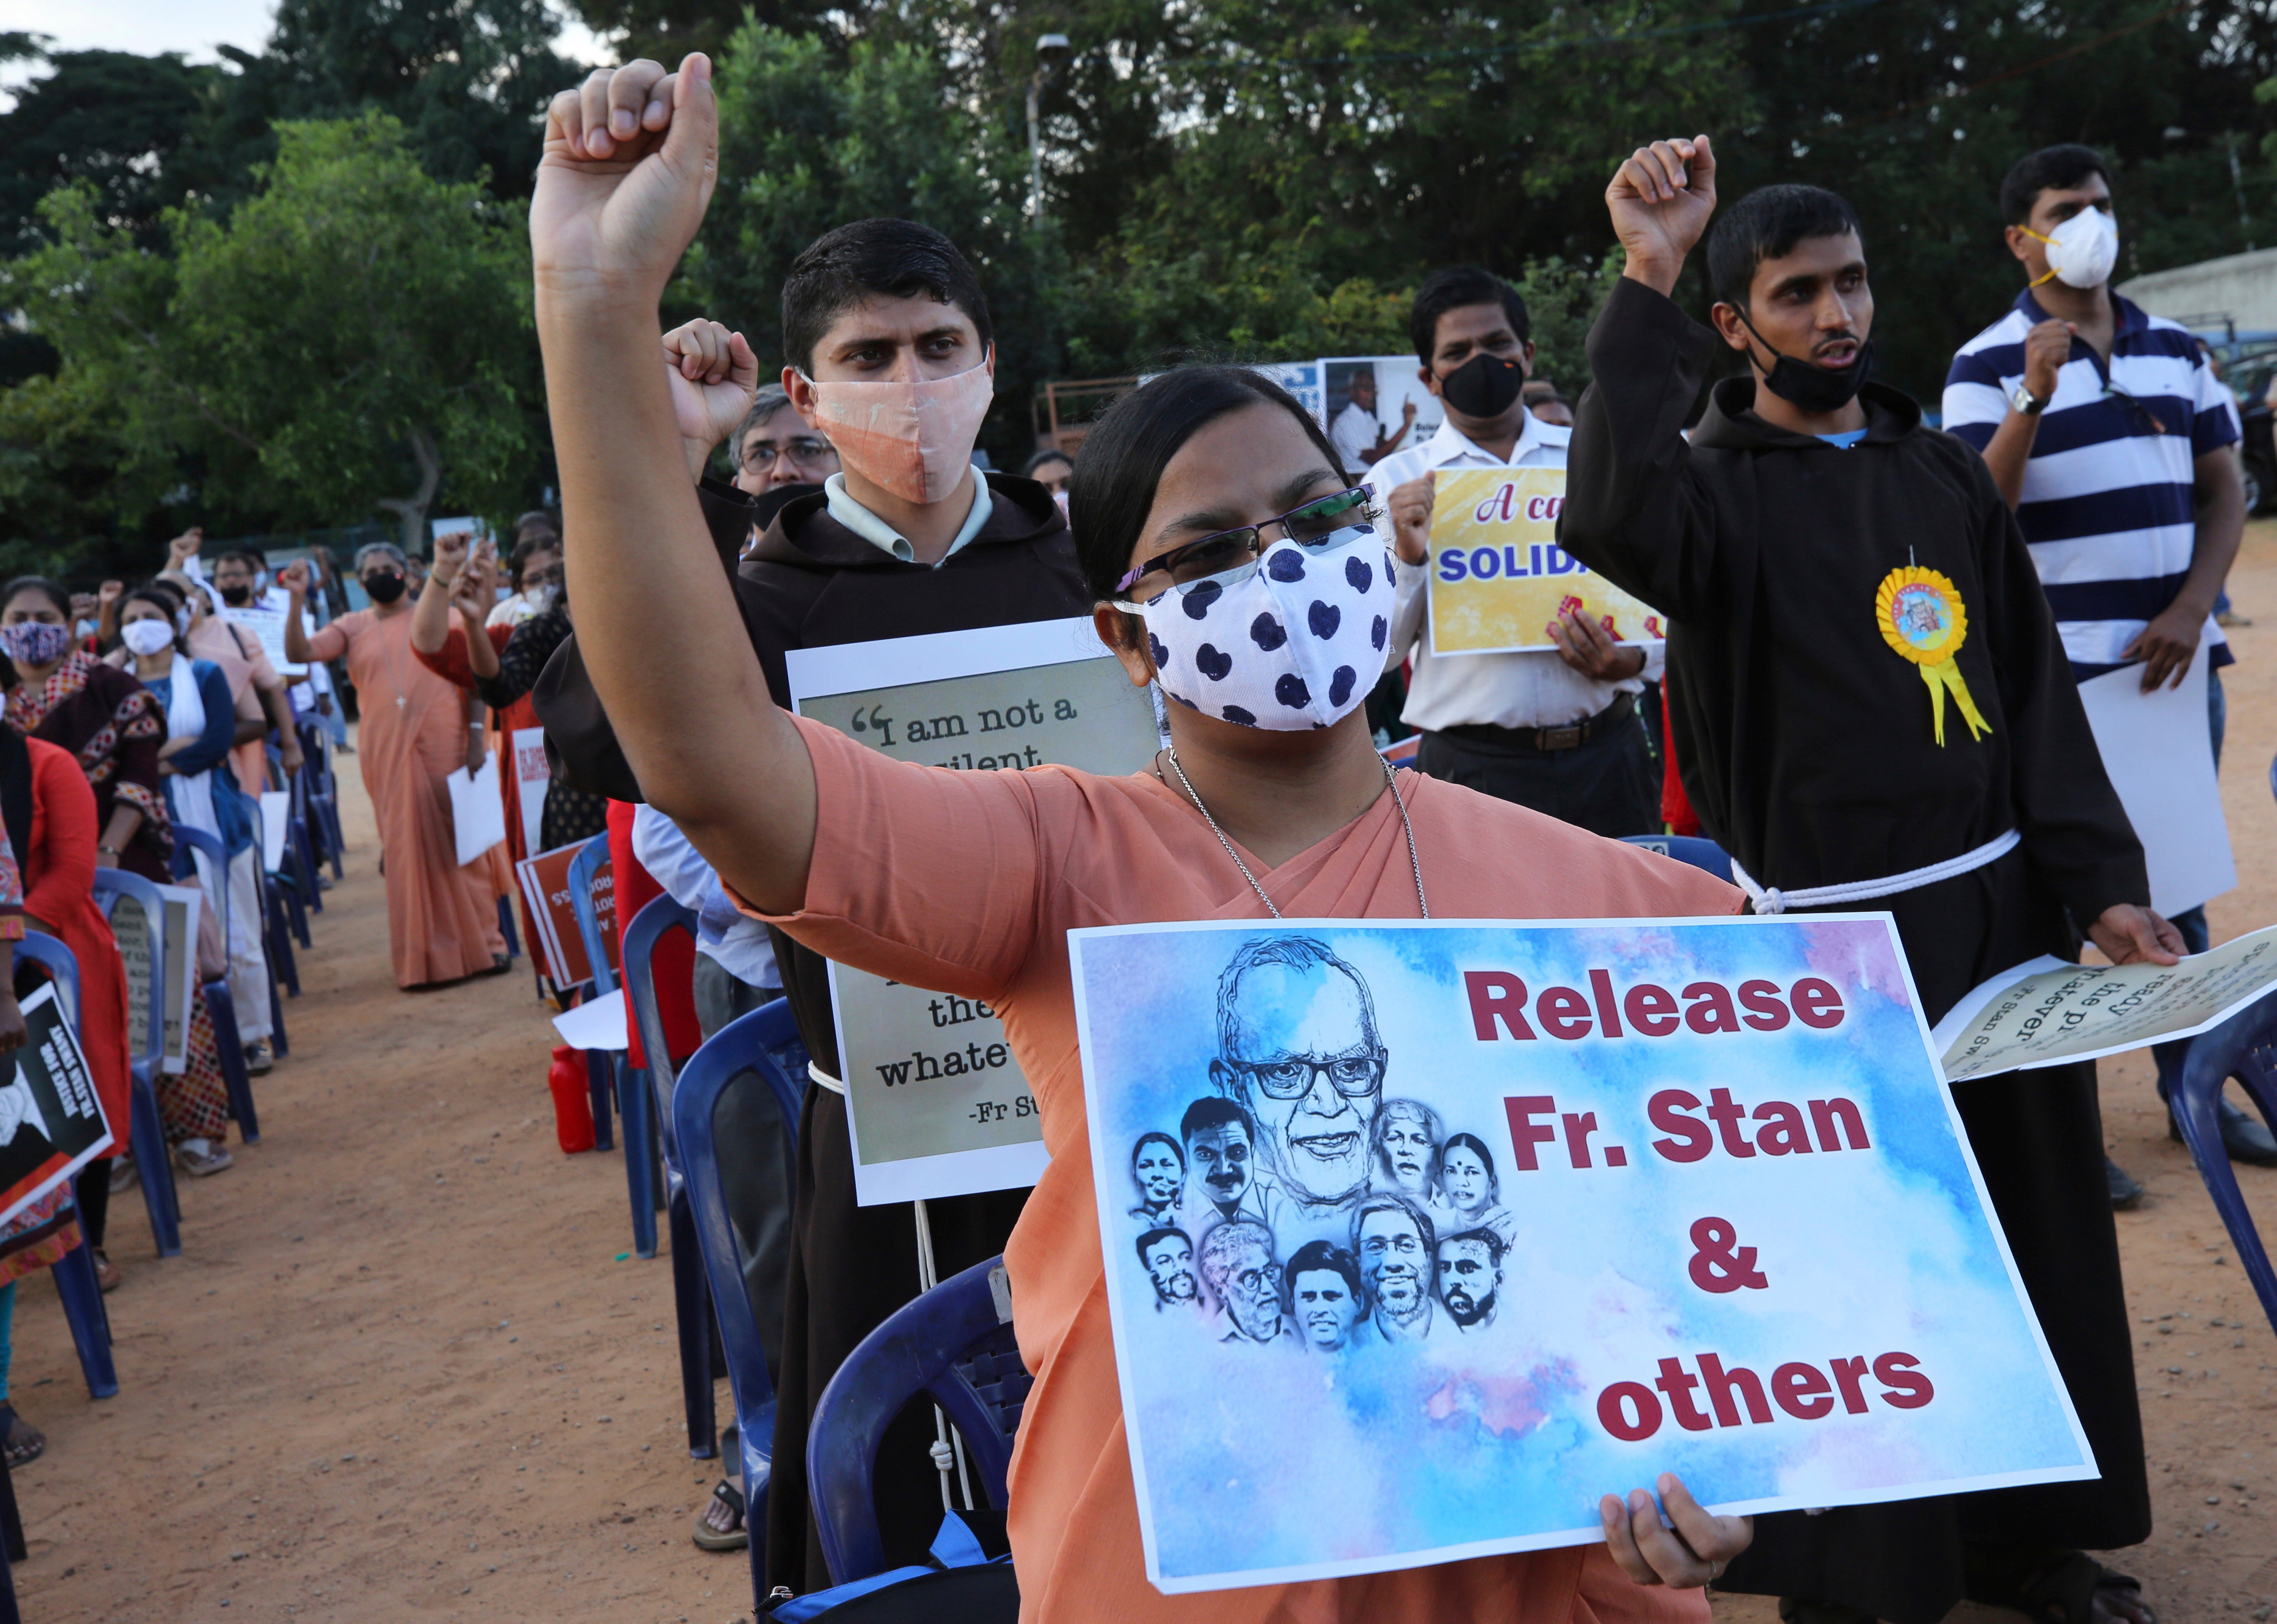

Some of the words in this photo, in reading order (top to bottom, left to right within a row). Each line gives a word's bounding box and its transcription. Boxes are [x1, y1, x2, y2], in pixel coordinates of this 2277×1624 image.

[1477, 484, 1517, 521] A
[1528, 497, 1565, 520] ca
[1439, 544, 1588, 582] SOLID
[907, 714, 969, 742] am
[978, 698, 1044, 732] not
[1054, 698, 1078, 721] a
[1464, 969, 1845, 1041] Release
[2081, 982, 2127, 1006] the
[2108, 973, 2176, 1016] ready
[1983, 1002, 2018, 1032] Stan
[875, 1042, 1011, 1087] whate
[969, 1101, 1008, 1123] -Fr
[1503, 1095, 1628, 1171] Fr.
[1647, 1087, 1871, 1163] Stan
[1688, 1216, 1769, 1294] &
[1596, 1351, 1934, 1441] others
